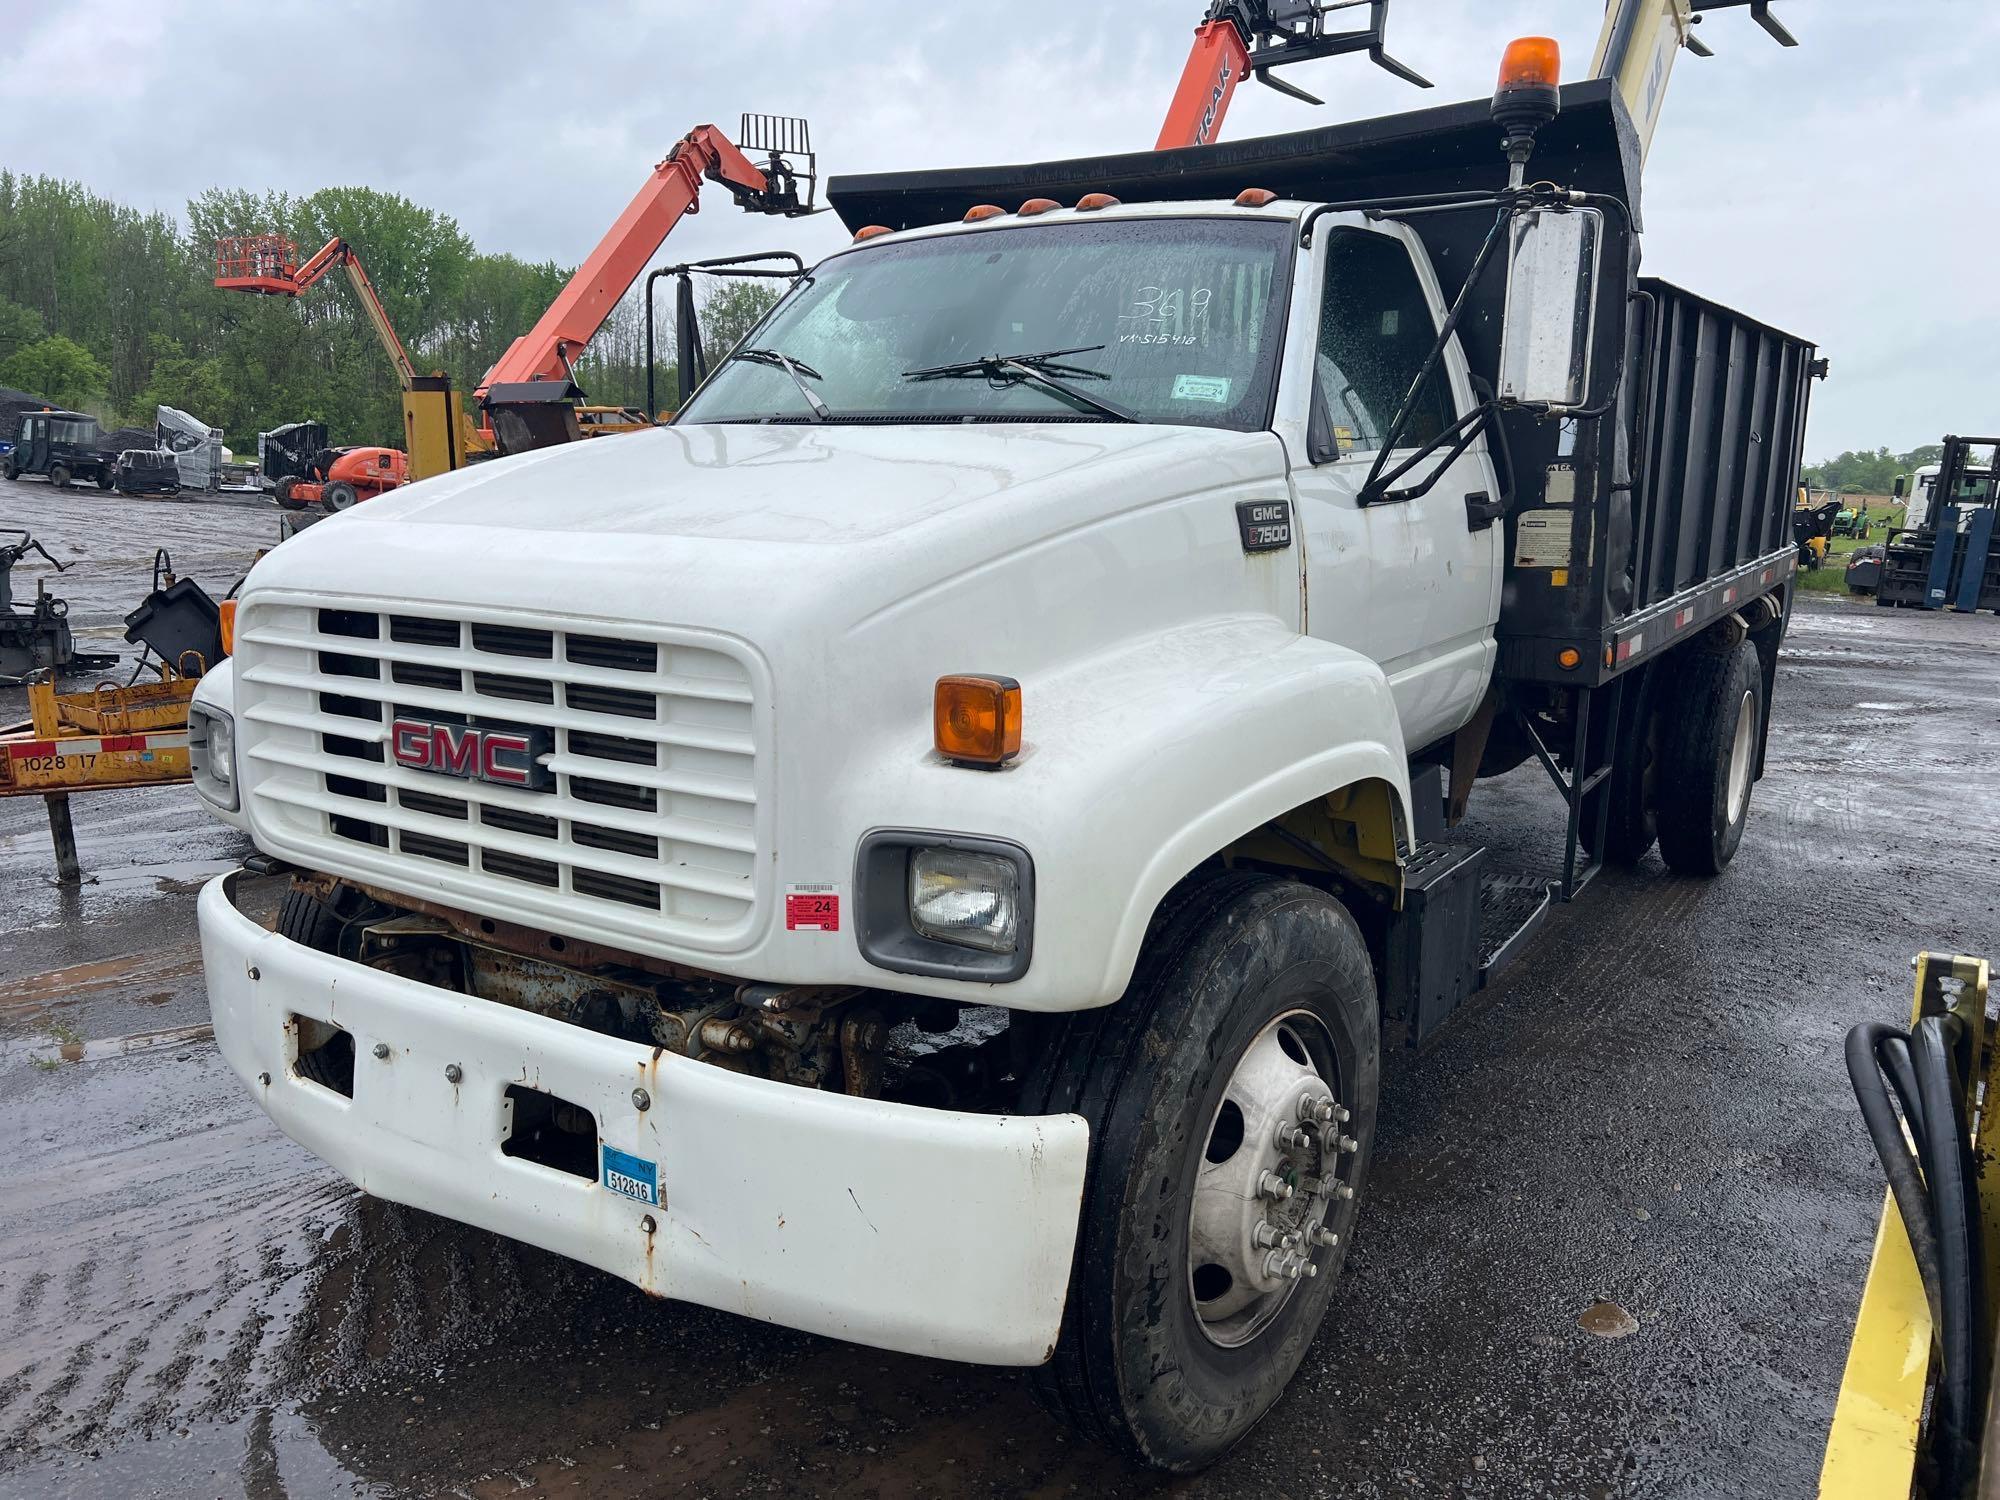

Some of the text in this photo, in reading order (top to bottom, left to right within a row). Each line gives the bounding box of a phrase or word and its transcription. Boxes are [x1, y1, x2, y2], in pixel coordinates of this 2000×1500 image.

[1211, 388, 1223, 396] 24
[1252, 506, 1283, 521] GMC
[392, 718, 531, 787] GMC
[814, 900, 831, 913] 24
[638, 1162, 654, 1176] NY
[611, 1172, 648, 1200] 512816
